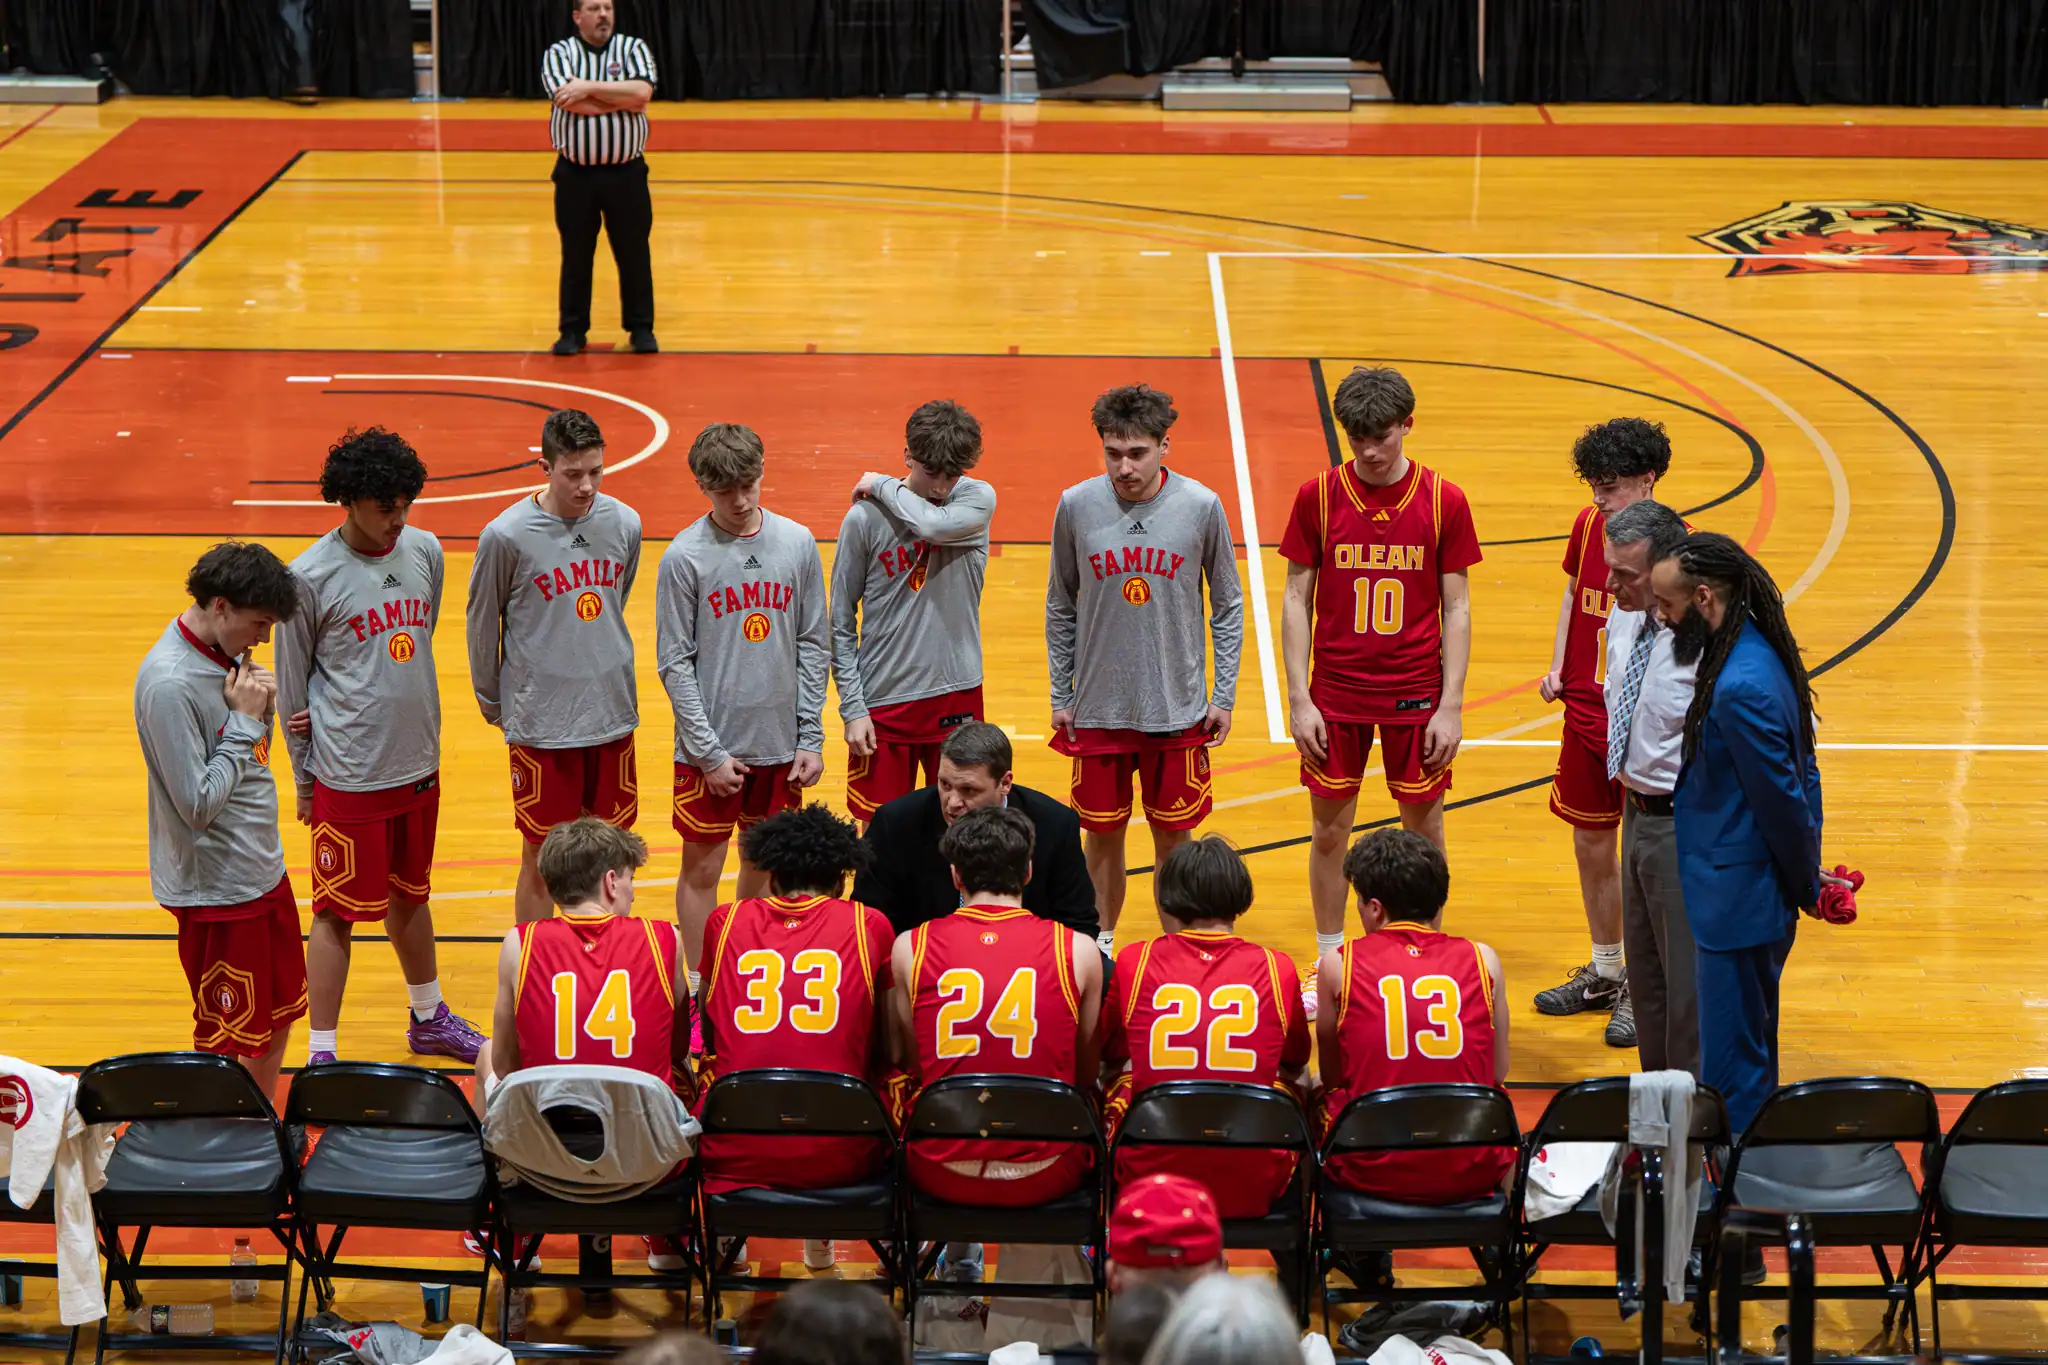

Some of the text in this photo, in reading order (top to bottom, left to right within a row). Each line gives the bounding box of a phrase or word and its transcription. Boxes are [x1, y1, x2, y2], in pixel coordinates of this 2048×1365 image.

[532, 559, 625, 602] FAMILY
[1088, 546, 1185, 580] FAMILY
[1335, 544, 1425, 571] OLEAN
[348, 599, 432, 643] FAMILY
[708, 581, 794, 619] FAMILY
[1353, 576, 1405, 635] 10
[1582, 587, 1617, 619] OLE
[551, 969, 636, 1060] 14
[734, 948, 842, 1034] 33
[936, 967, 1038, 1059] 24
[1149, 983, 1259, 1072] 22
[1378, 974, 1464, 1061] 13
